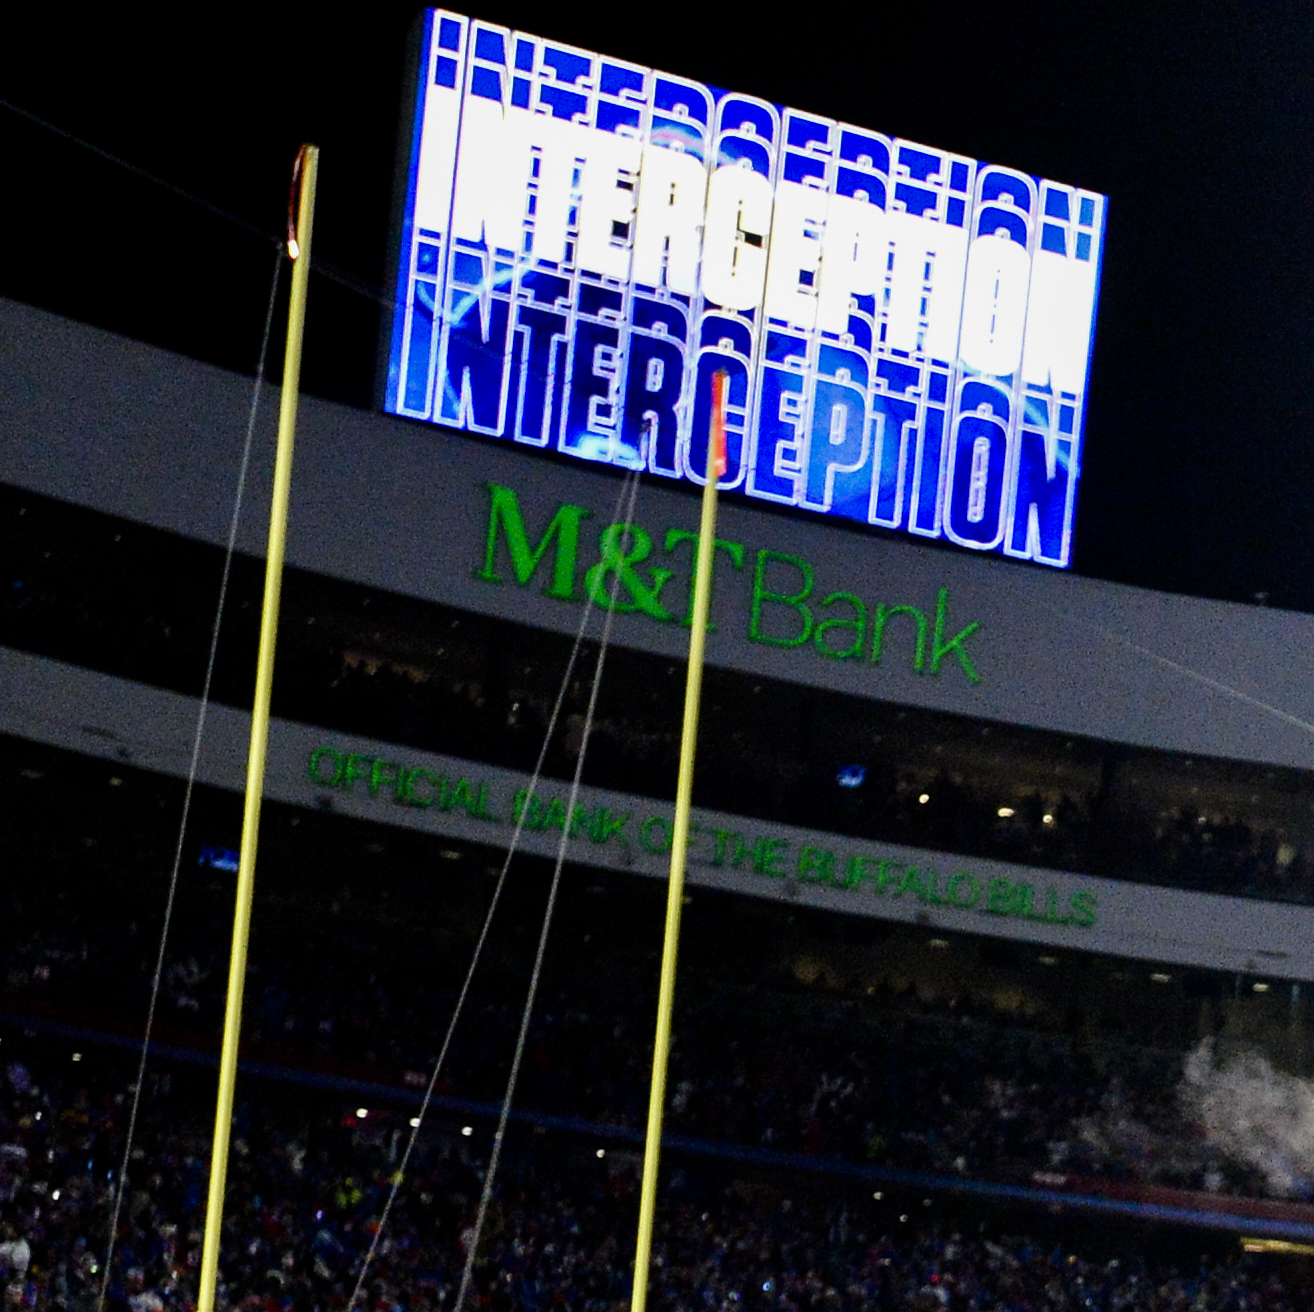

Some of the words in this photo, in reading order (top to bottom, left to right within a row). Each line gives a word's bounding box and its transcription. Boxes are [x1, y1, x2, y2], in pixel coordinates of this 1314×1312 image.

[397, 276, 1080, 568] INTERCEPTION
[474, 483, 744, 633] M&T
[749, 549, 980, 683] Bank
[309, 746, 499, 823] OFFICIAL
[511, 788, 632, 846] BANK
[707, 826, 790, 879] THE
[797, 843, 981, 913] BUFFALO
[984, 876, 1098, 929] BILLS
